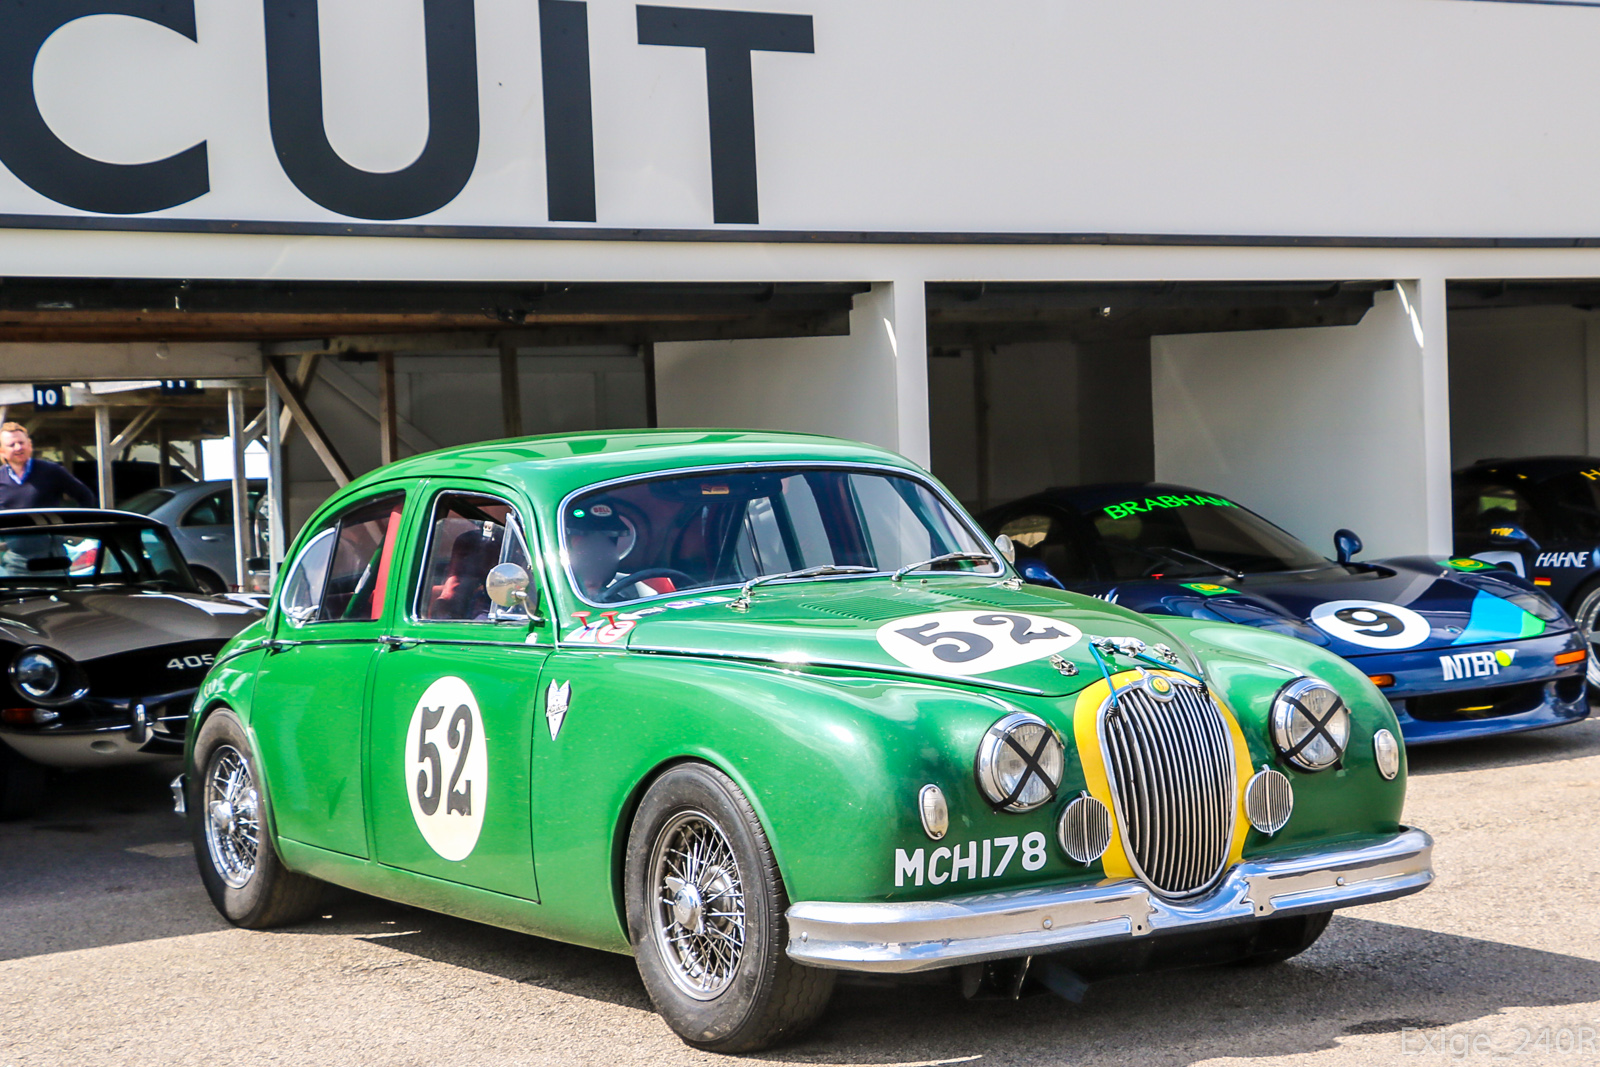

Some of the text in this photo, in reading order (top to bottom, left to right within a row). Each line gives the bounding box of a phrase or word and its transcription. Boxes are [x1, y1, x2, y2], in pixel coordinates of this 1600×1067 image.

[0, 0, 815, 222] CUIT
[37, 389, 57, 406] 10
[1103, 494, 1239, 520] BRABHAM
[1535, 551, 1589, 568] HAHNE
[1334, 607, 1406, 638] 9
[894, 614, 1071, 663] 52
[166, 653, 215, 670] 405
[1439, 651, 1499, 681] INTER
[416, 703, 474, 817] 52
